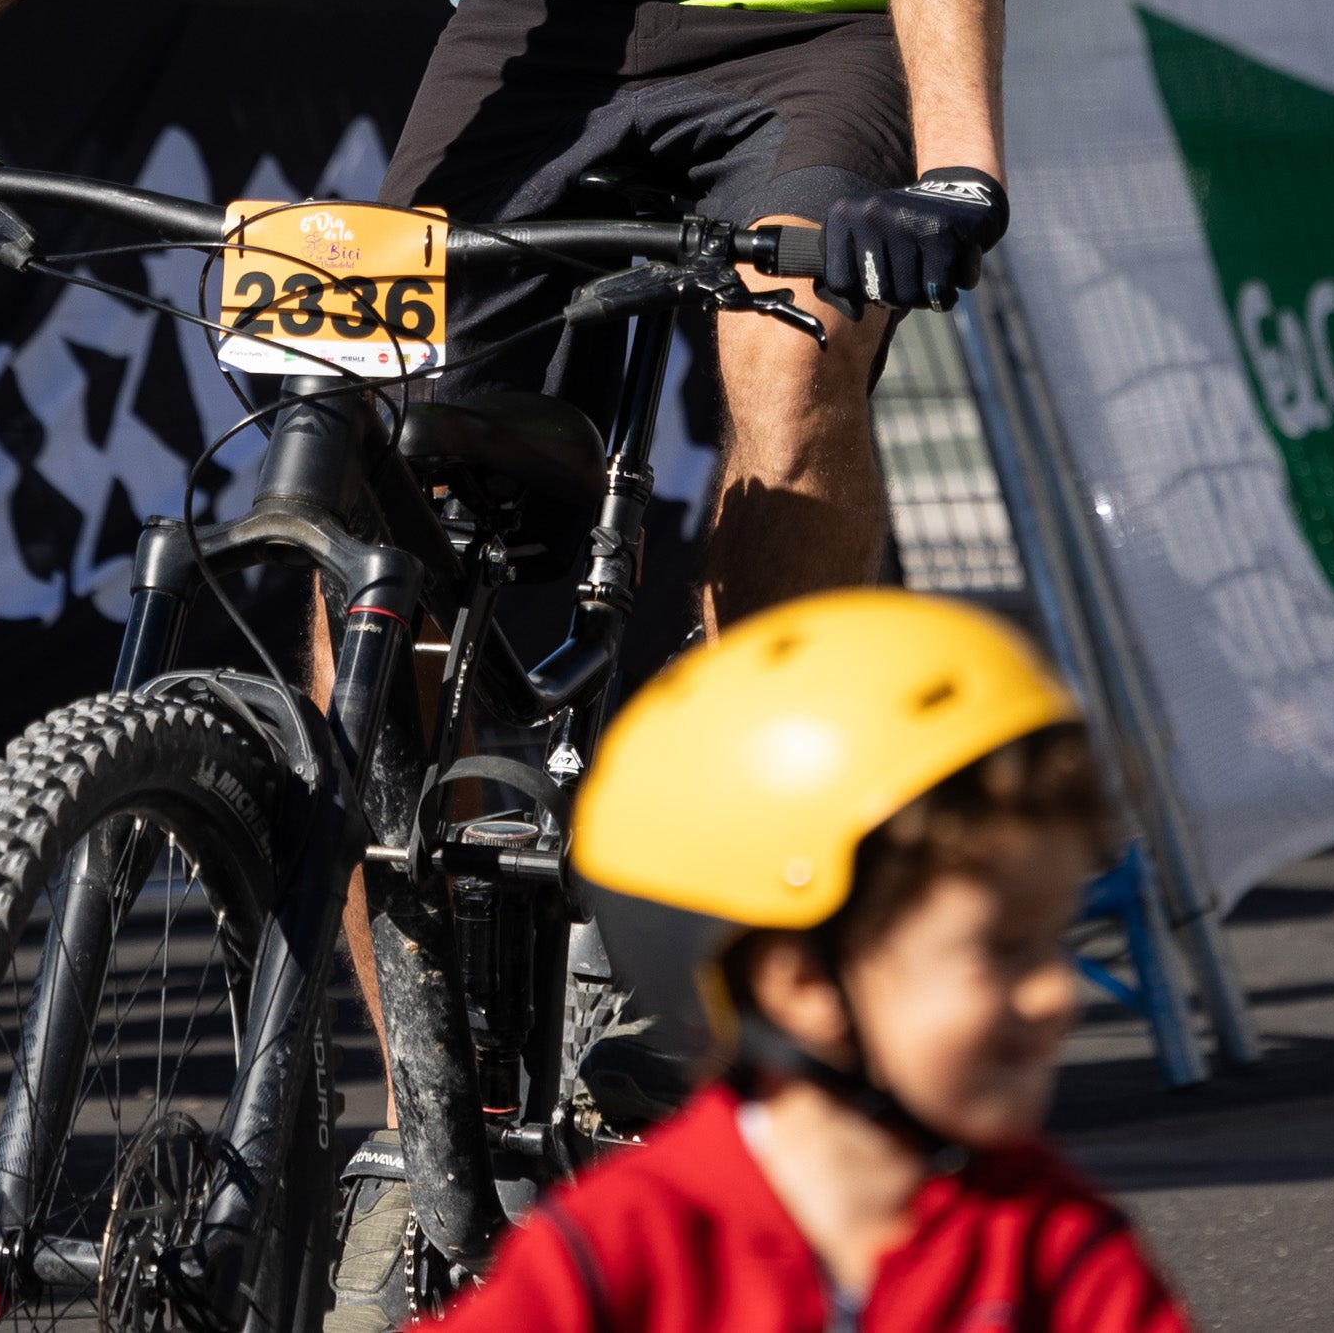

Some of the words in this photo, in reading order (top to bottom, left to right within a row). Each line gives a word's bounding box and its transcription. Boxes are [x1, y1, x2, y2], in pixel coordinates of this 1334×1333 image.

[327, 242, 361, 261] Bici
[233, 270, 436, 342] 2336
[313, 1016, 329, 1151] NDURO
